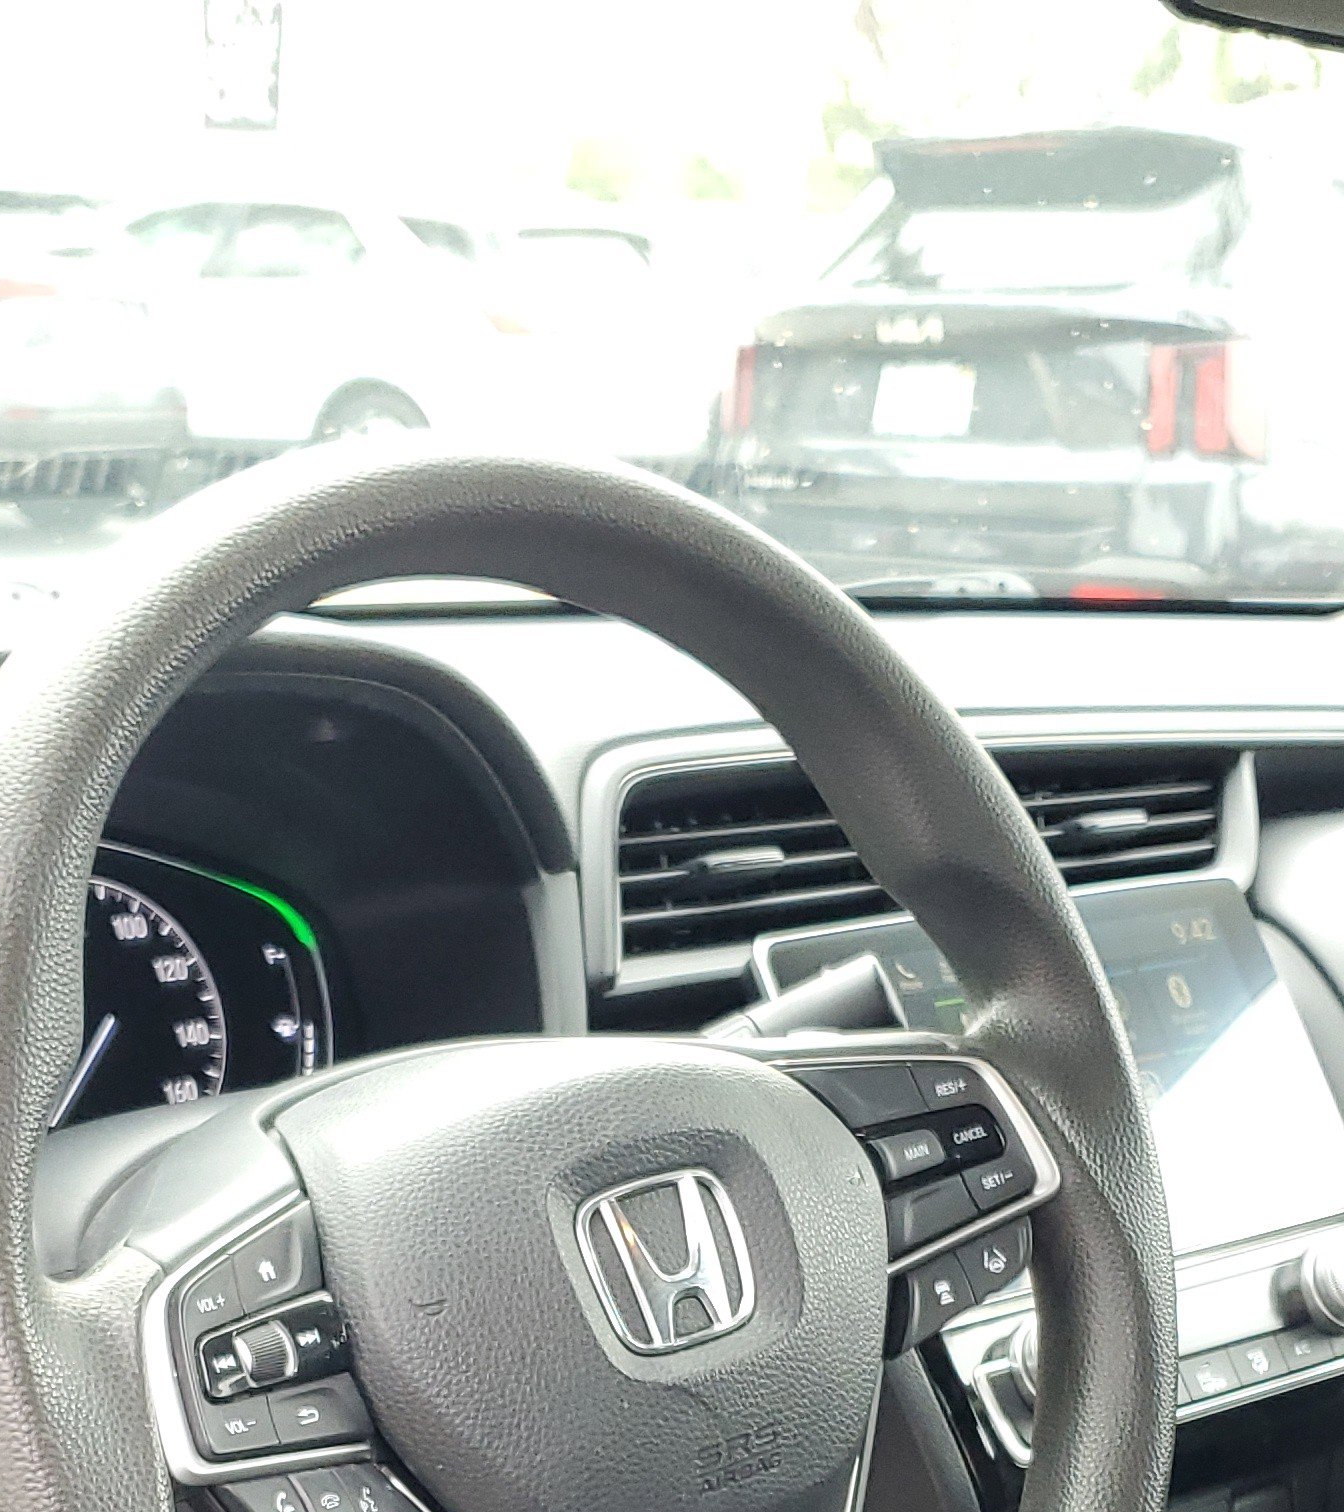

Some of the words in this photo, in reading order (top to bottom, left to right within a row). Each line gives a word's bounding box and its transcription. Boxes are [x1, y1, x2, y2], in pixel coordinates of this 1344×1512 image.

[111, 912, 148, 940] 100
[152, 954, 189, 982] 120
[172, 1016, 210, 1047] 140
[162, 1074, 199, 1105] 160
[952, 1125, 989, 1145] CANCEL
[903, 1144, 931, 1162] MAIN
